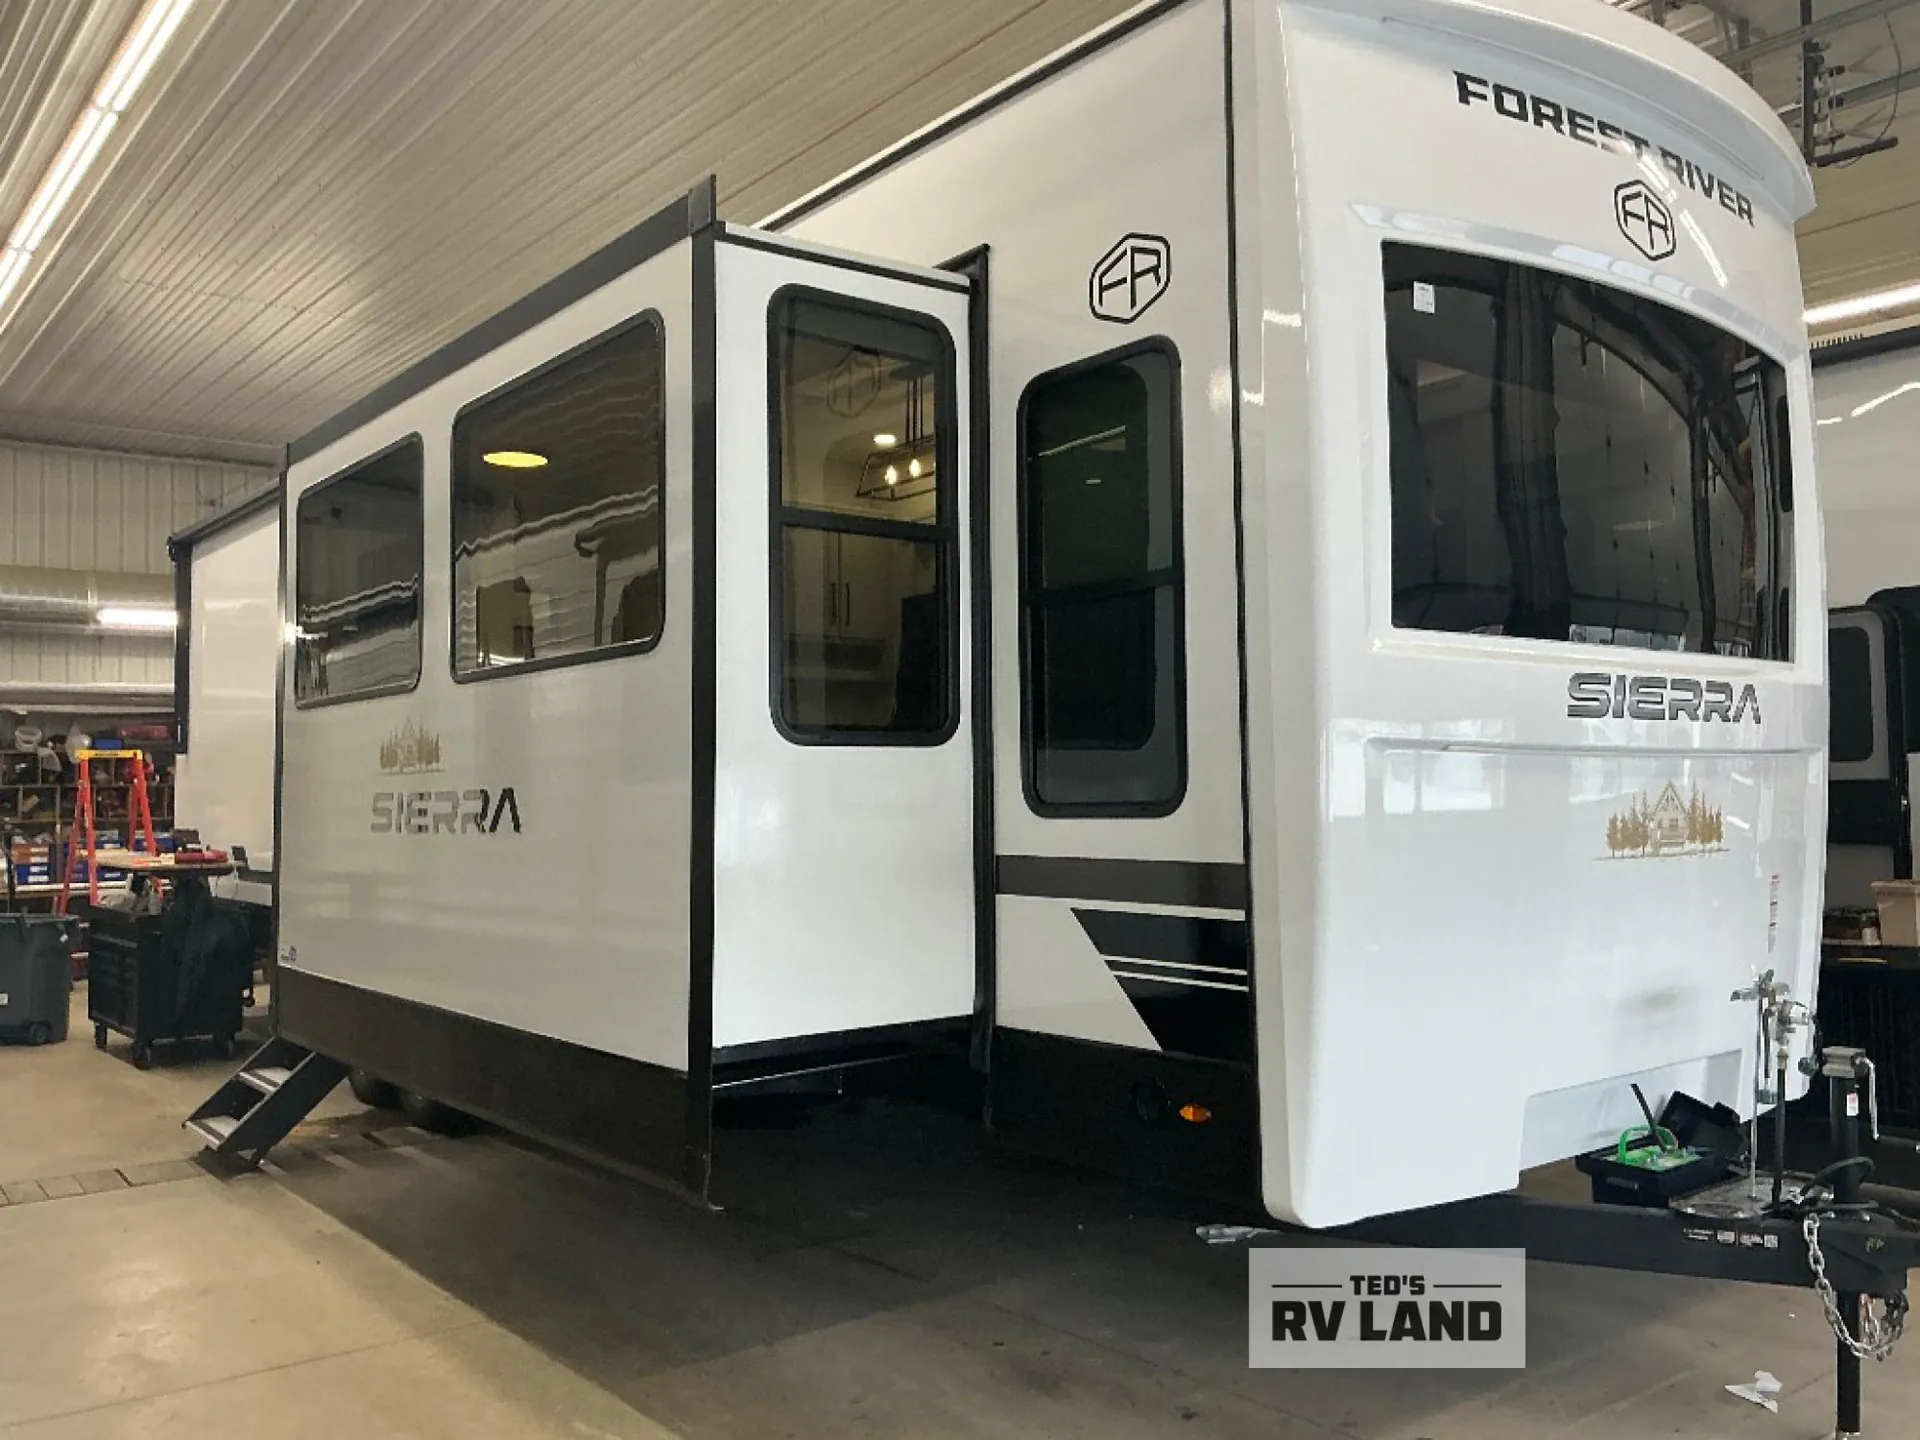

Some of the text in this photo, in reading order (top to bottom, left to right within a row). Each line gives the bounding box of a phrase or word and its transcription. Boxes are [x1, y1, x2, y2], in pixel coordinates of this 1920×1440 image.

[1453, 70, 1755, 227] FOREST RIVER
[1567, 673, 1761, 724] SIERRA
[371, 787, 522, 834] SIERRA
